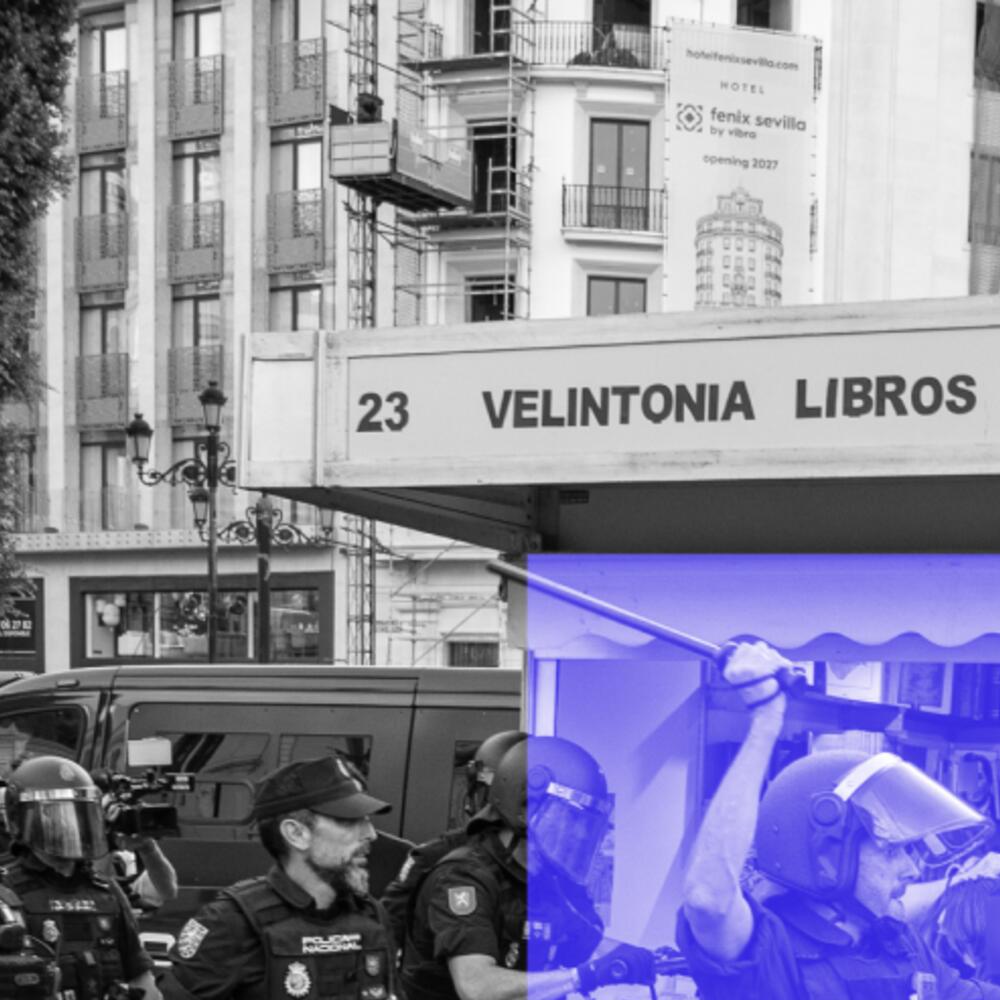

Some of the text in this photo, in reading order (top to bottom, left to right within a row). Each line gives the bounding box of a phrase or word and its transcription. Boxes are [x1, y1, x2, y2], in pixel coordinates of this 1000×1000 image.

[686, 48, 799, 71] hotelfenixsevilla.com
[720, 80, 764, 94] HOTEL
[710, 107, 807, 132] fenix sevilla
[710, 126, 757, 139] by vibra
[703, 154, 778, 170] opening 2027
[356, 374, 977, 433] 23 VELINTONIA LIBROS
